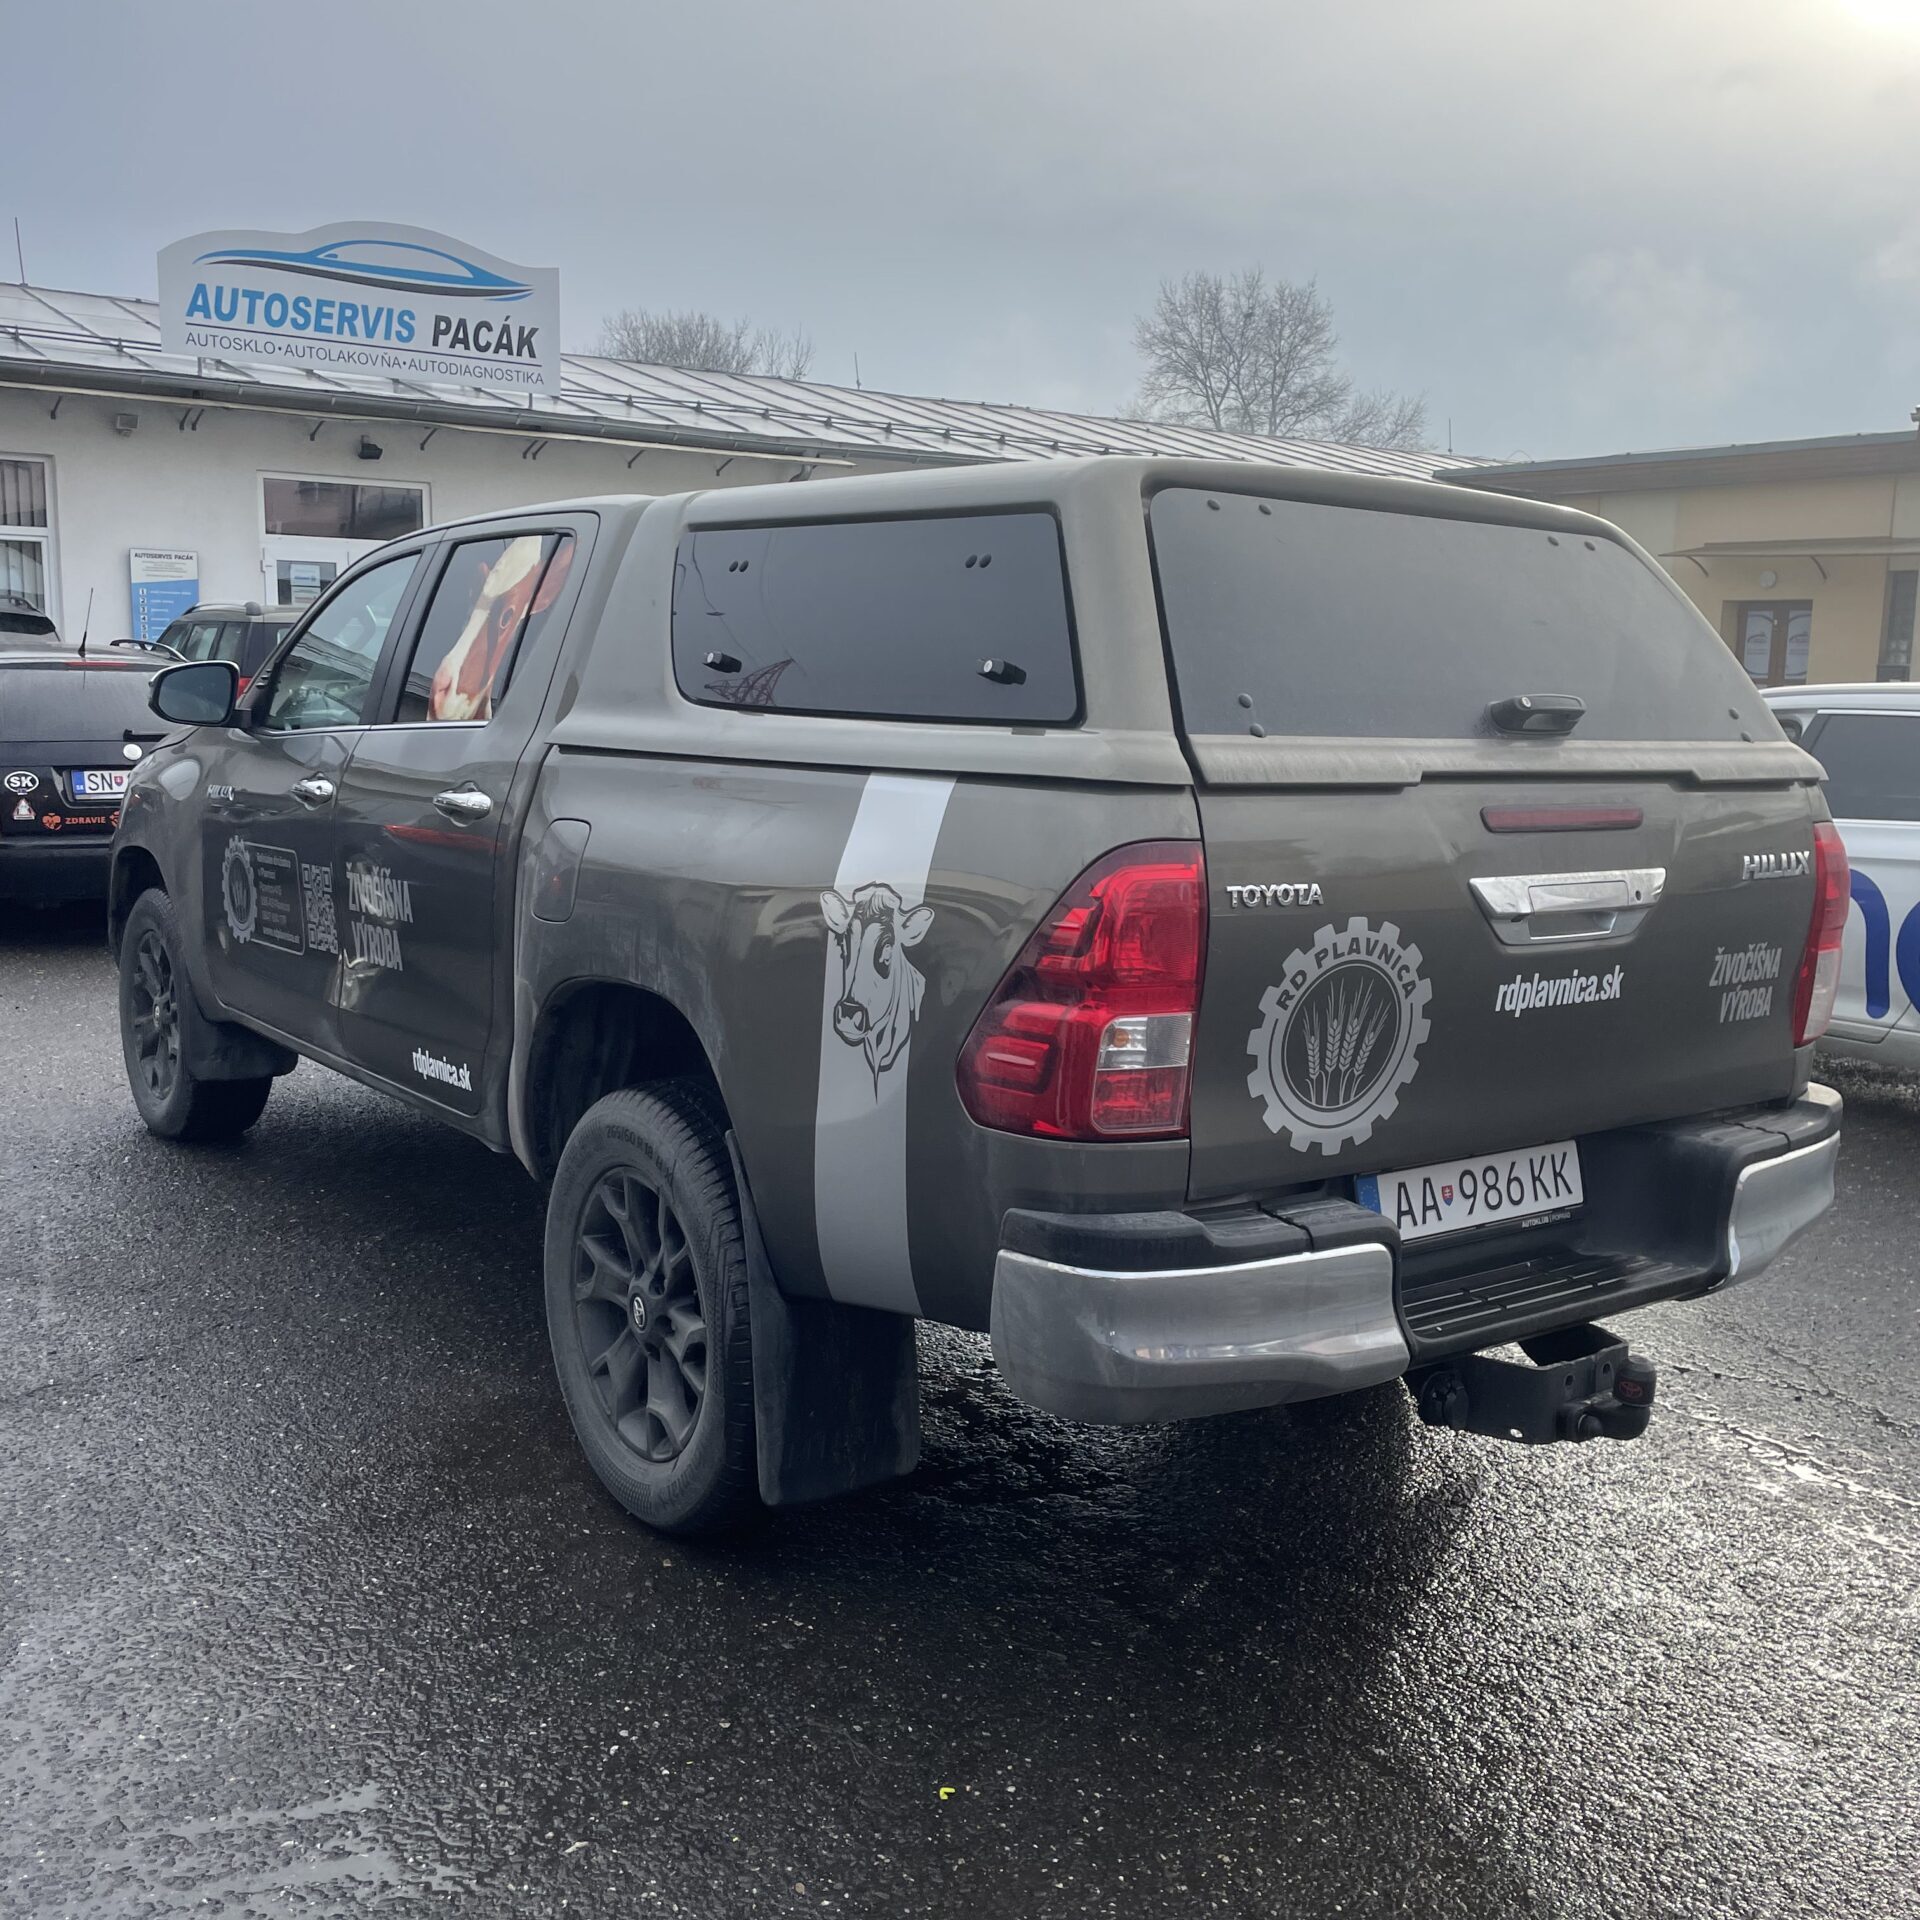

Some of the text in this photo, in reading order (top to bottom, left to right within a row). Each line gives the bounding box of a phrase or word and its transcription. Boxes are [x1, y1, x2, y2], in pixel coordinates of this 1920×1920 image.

[186, 283, 539, 359] AUTOSERVIS PACÁK
[185, 332, 545, 385] AUTOSKLO AUTOLAKOVŇA AUTODIAGNOSTIKA
[134, 552, 194, 561] AUTOSERVIS PACÁK
[9, 776, 34, 788] SK
[87, 773, 113, 791] SN
[64, 816, 106, 825] ZDRAVIE
[1742, 851, 1810, 880] HILUX
[1226, 883, 1325, 908] TOYOTA
[351, 915, 403, 972] VÝROBA
[1709, 941, 1783, 987] ŽIVOČÍŠNA
[1276, 936, 1418, 1011] RD PLAVNICA
[1495, 964, 1625, 1018] rdplavnica.sk
[1719, 984, 1774, 1024] VÝROBA
[412, 1047, 473, 1092] rdplavnica.sk
[1396, 1151, 1573, 1229] AA 986KK
